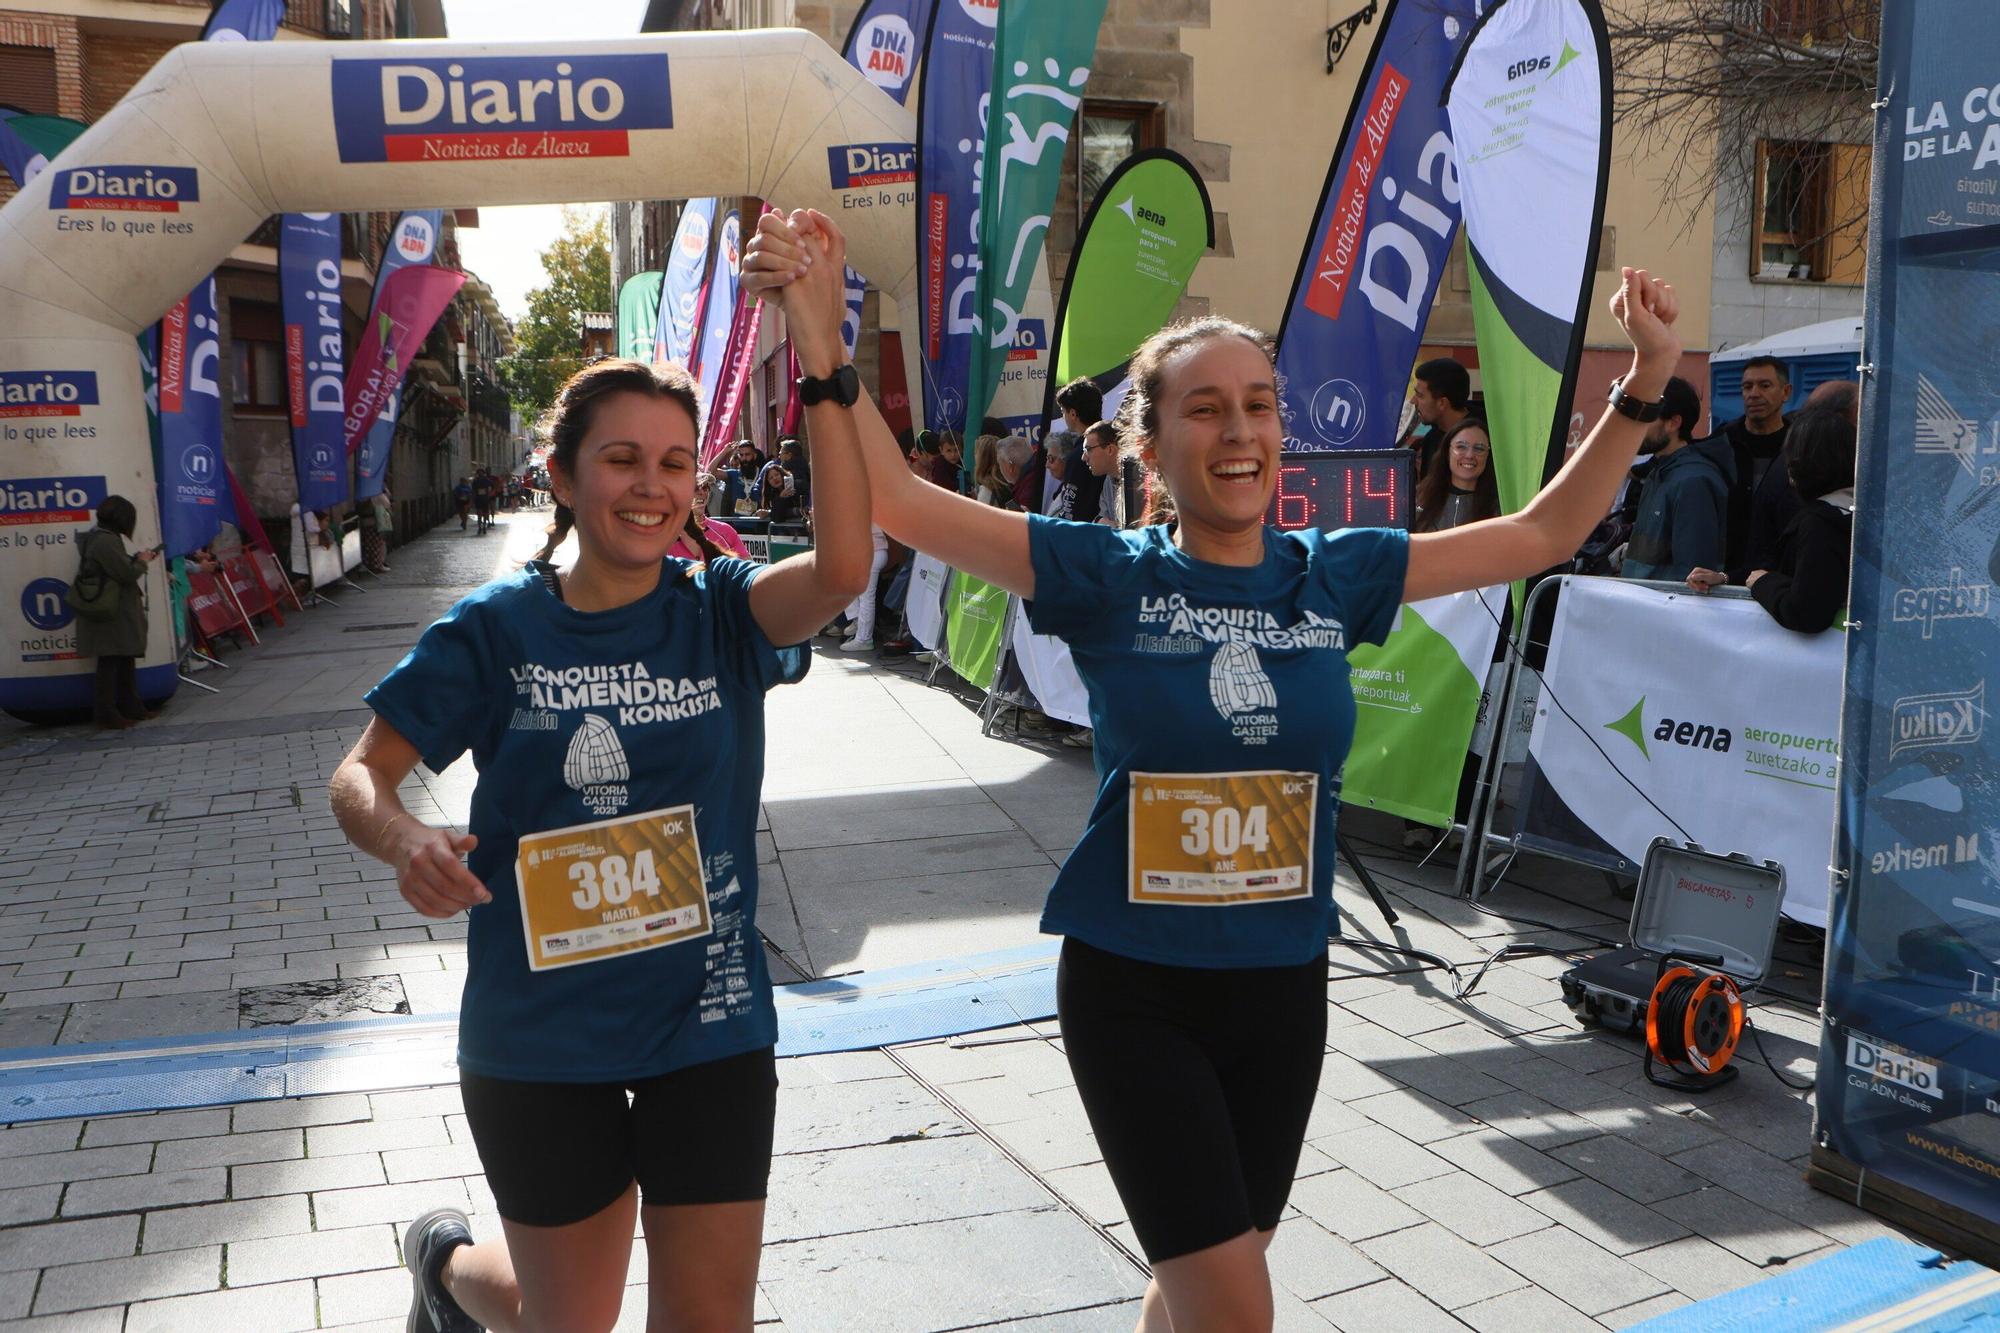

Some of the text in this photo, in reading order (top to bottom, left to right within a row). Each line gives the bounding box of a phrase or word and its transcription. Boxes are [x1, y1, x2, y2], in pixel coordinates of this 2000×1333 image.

[977, 39, 987, 48] de
[381, 62, 625, 125] Diario
[1905, 101, 1949, 135] LA
[423, 131, 591, 159] Noticias de Álava
[1903, 138, 1936, 161] DE
[1942, 131, 1972, 155] LA
[847, 146, 916, 174] Diari
[69, 169, 178, 198] Diario
[1320, 78, 1400, 291] Noticias de Álava
[843, 191, 914, 209] Eres lo qu
[57, 215, 194, 238] Eres lo que lees
[1137, 206, 1166, 227] aena
[403, 224, 426, 239] DNA
[401, 238, 426, 254] ADN
[305, 259, 345, 413] Diario
[161, 310, 185, 396] Noticias de
[0, 374, 79, 403] iario
[1326, 394, 1351, 436] n
[4, 422, 96, 443] lo que lees
[193, 455, 207, 472] n
[0, 481, 88, 510] iario
[177, 484, 216, 497] noticias
[1277, 466, 1396, 527] 6:14
[15, 532, 67, 550] lo que
[36, 589, 61, 616] n
[1140, 593, 1280, 629] LA CONQUISTA
[1139, 613, 1156, 622] DE
[21, 636, 79, 651] noticia
[1149, 634, 1203, 653] Edición
[526, 661, 650, 687] CONQUISTA
[1395, 670, 1405, 683] ti
[530, 677, 699, 711] ALMENDRA
[619, 690, 722, 726] KONKISTA
[1231, 714, 1278, 726] VITORIA
[1232, 725, 1279, 736] GASTEIZ
[1242, 737, 1267, 745] 2025
[1654, 718, 1732, 752] aena
[1746, 750, 1821, 776] zuretzako
[582, 795, 629, 806] GASTEIZ
[583, 785, 628, 797] VITORIA
[1282, 781, 1304, 796] 10K
[593, 806, 618, 816] 2025
[662, 821, 684, 837] 10K
[1181, 805, 1270, 856] 304
[1215, 860, 1237, 874] ANE
[568, 848, 661, 911] 384
[602, 906, 641, 924] MARTA
[1854, 1040, 1930, 1089] Diario
[1848, 1074, 1933, 1114] Con ADN alavés
